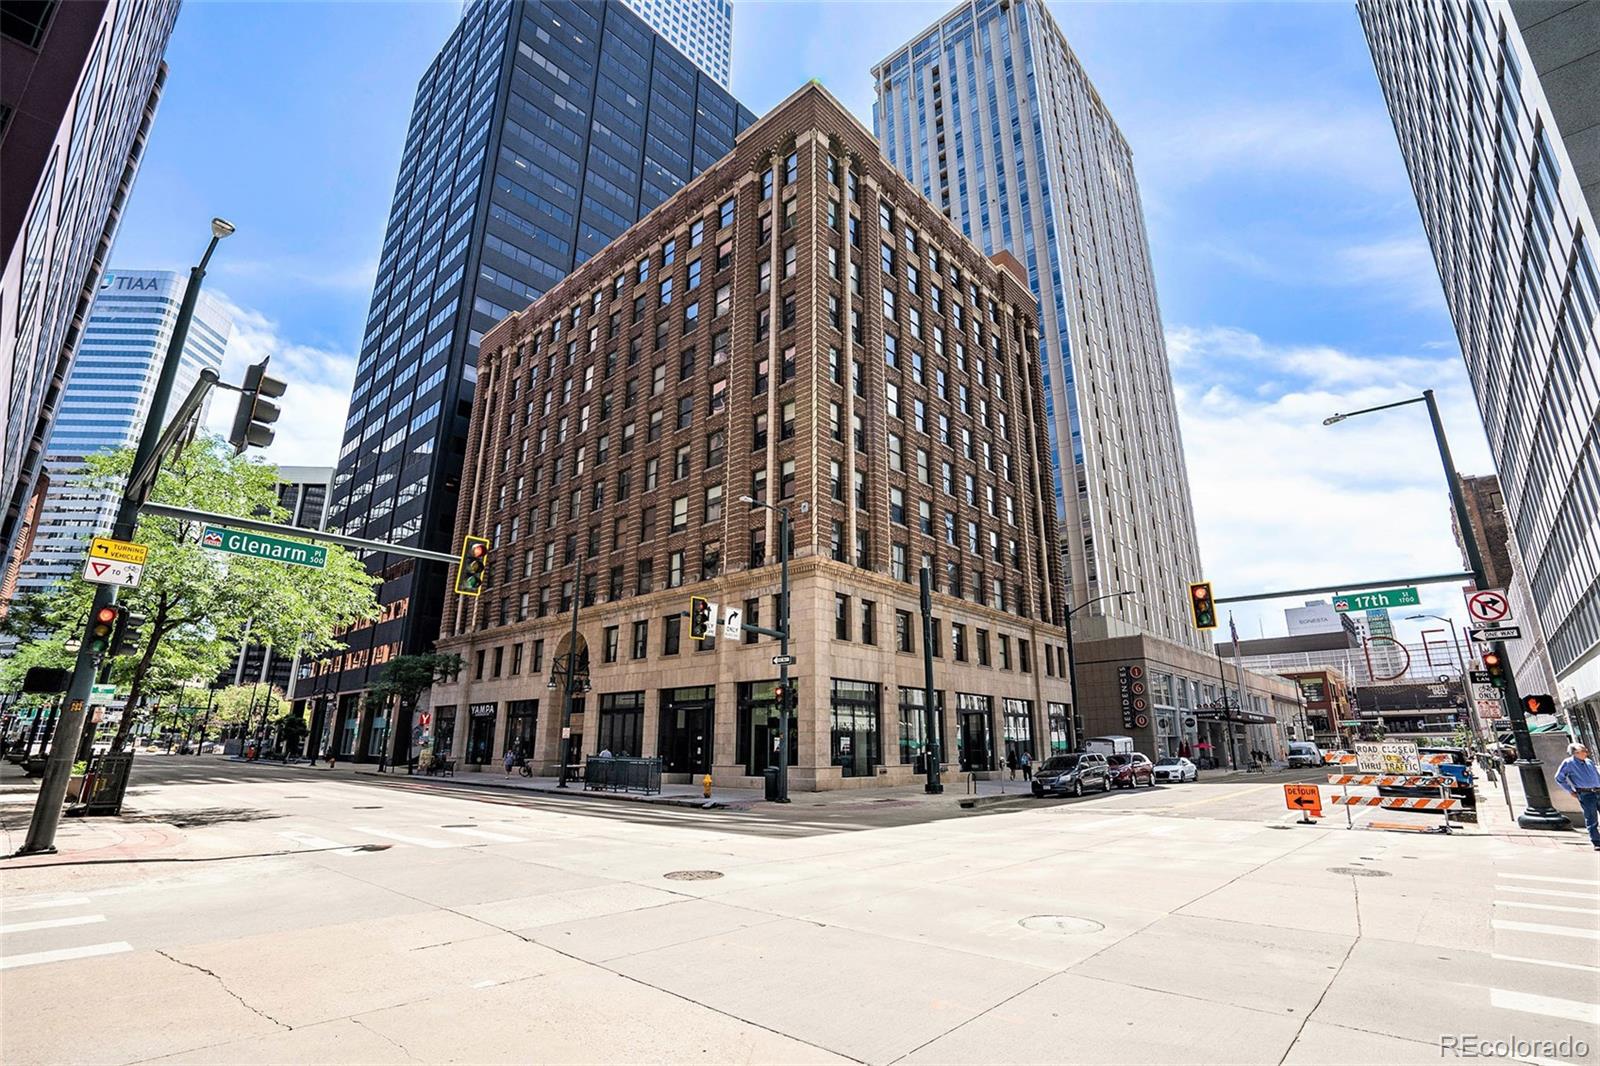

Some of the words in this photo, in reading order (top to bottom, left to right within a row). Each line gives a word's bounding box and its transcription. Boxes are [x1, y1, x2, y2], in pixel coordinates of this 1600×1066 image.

[115, 276, 158, 291] TIAA
[113, 544, 145, 555] TURNING
[228, 535, 307, 562] Glenarm
[110, 552, 144, 562] VEHICLES
[310, 556, 324, 564] 500
[1355, 594, 1389, 608] 17th
[1119, 667, 1132, 728] RESIDENCES
[471, 704, 494, 714] YAMPA
[1356, 745, 1378, 754] ROAD
[1382, 745, 1415, 755] CLOSED
[1360, 762, 1382, 771] THRU
[1385, 762, 1419, 772] TRAFFIC
[1287, 788, 1316, 796] DETOUR
